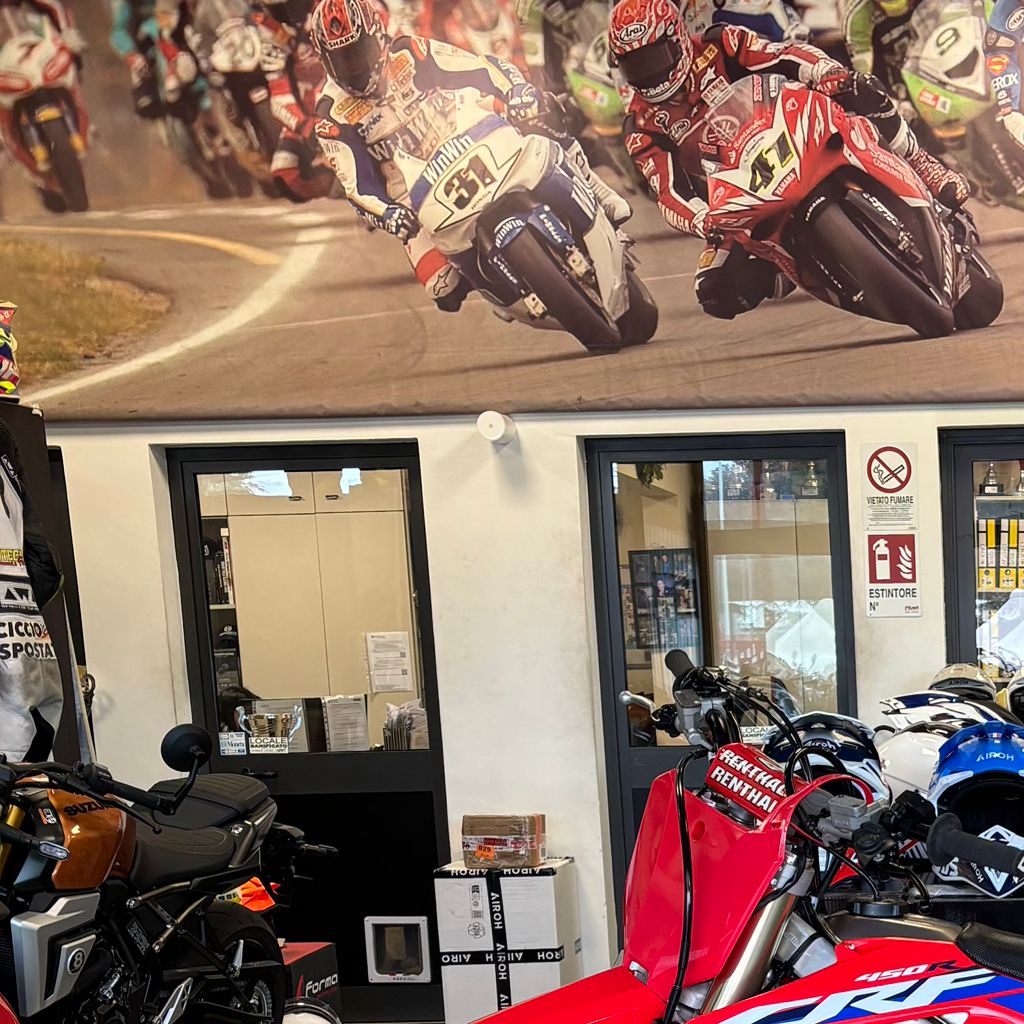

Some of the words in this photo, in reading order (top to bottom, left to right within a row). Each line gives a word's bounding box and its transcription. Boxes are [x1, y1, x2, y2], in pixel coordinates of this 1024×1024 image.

[329, 34, 356, 48] SHARK
[621, 26, 645, 40] Arai
[992, 72, 1018, 92] EROX
[733, 117, 767, 150] Santander
[423, 135, 473, 185] WinWin
[750, 131, 793, 192] 41
[444, 155, 496, 210] 31
[774, 173, 796, 196] YAMAHA
[867, 496, 888, 504] VIETATO
[890, 496, 914, 504] FUMARE
[869, 588, 917, 598] ESTINTORE
[976, 752, 1015, 762] AIROH
[718, 749, 788, 797] RENTHAL
[490, 892, 503, 930] AIROH
[441, 954, 471, 963] AIRO
[496, 943, 508, 980] AIROH
[854, 960, 959, 982] 450R
